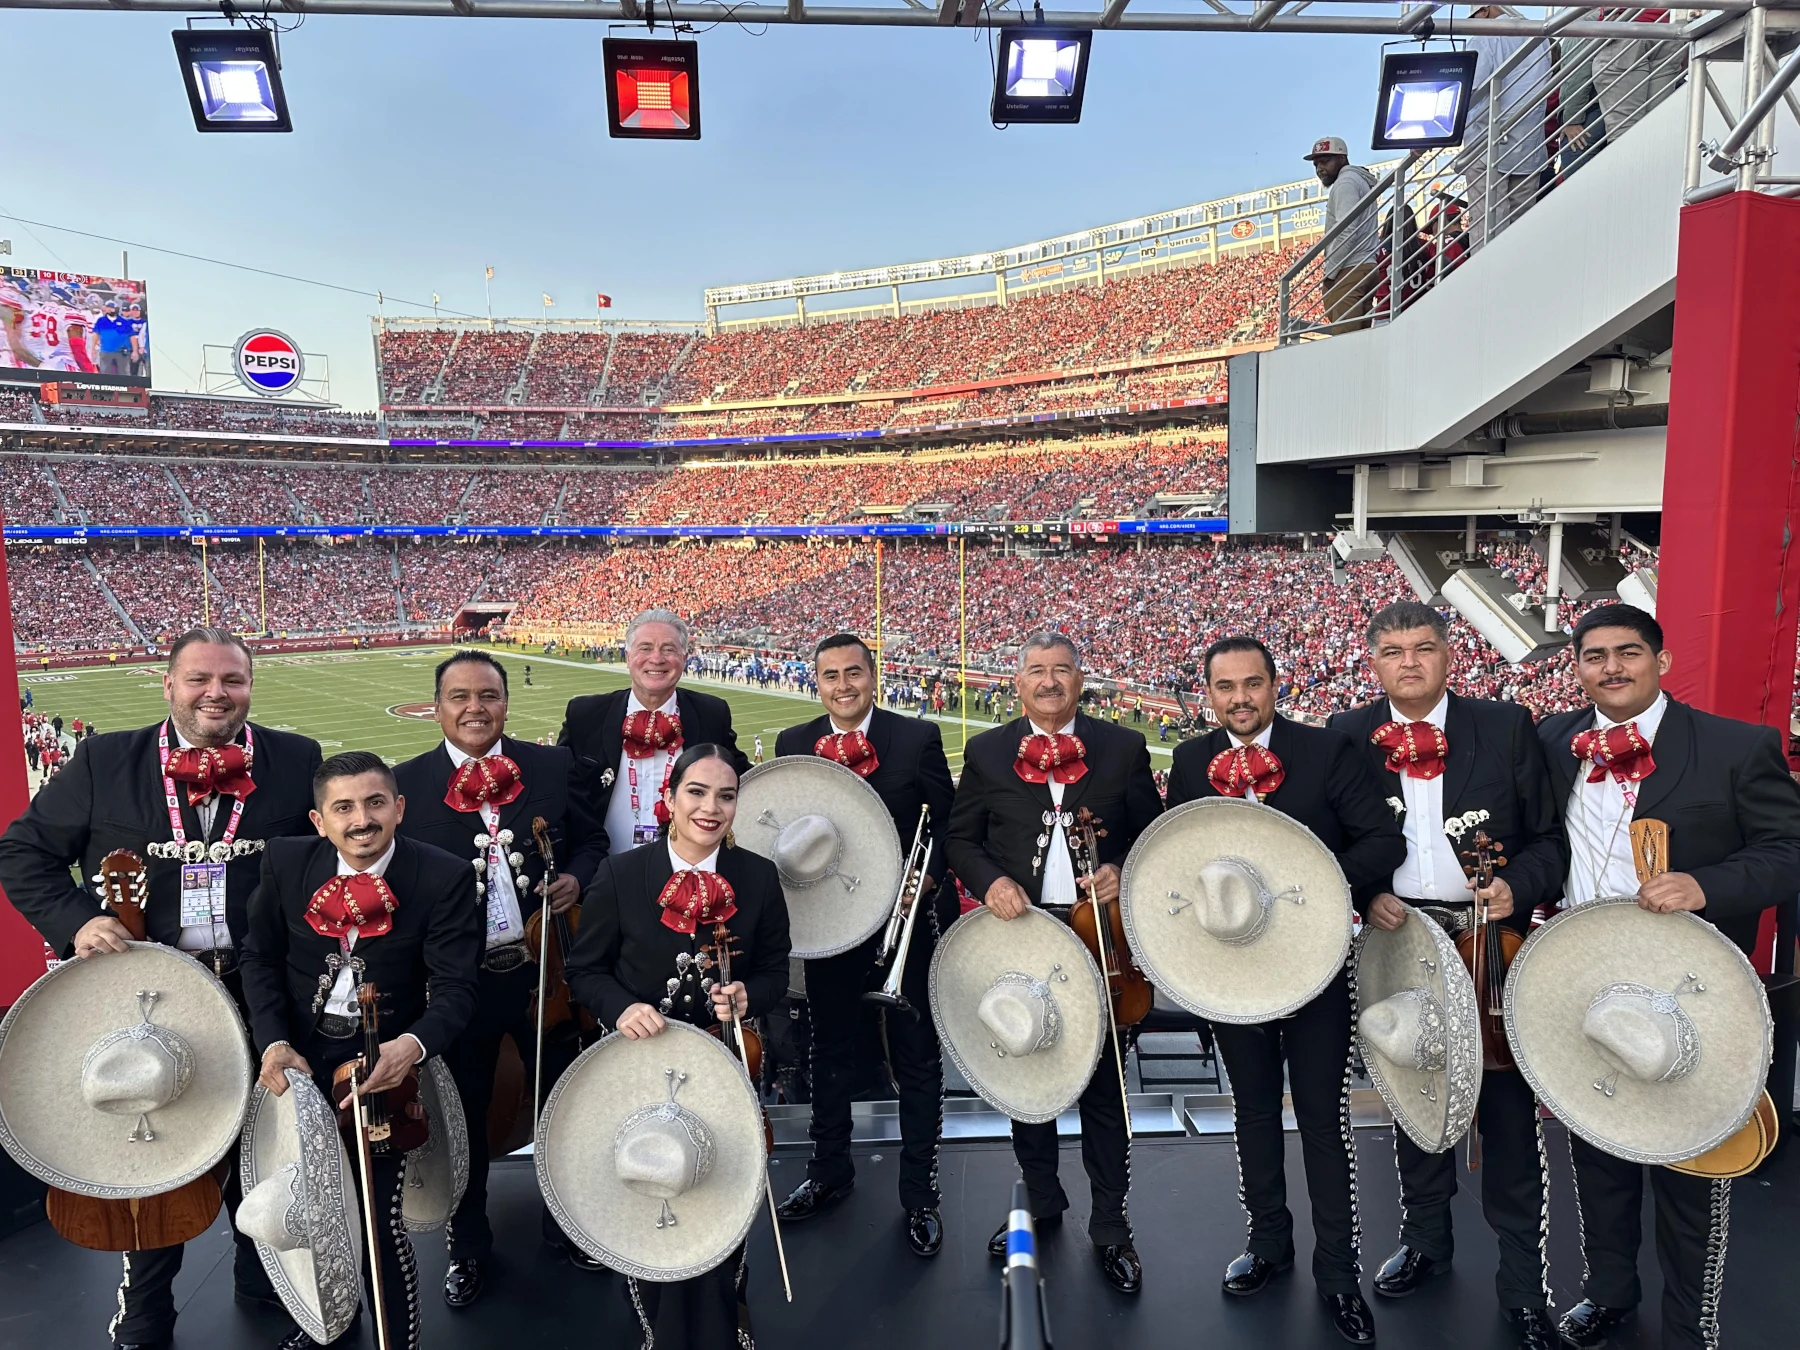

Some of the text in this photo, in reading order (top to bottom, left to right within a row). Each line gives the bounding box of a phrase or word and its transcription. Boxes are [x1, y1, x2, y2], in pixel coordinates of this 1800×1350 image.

[1294, 218, 1319, 228] CISCO
[1170, 236, 1200, 247] UNITED
[1106, 250, 1122, 261] SAP
[1141, 248, 1156, 258] nrg
[244, 354, 296, 370] PEPSI
[1184, 398, 1208, 406] PASSING
[1074, 406, 1120, 418] GAME STATS
[1136, 525, 1146, 533] nrg
[171, 810, 180, 827] 49ERS
[228, 814, 240, 832] 49ERS
